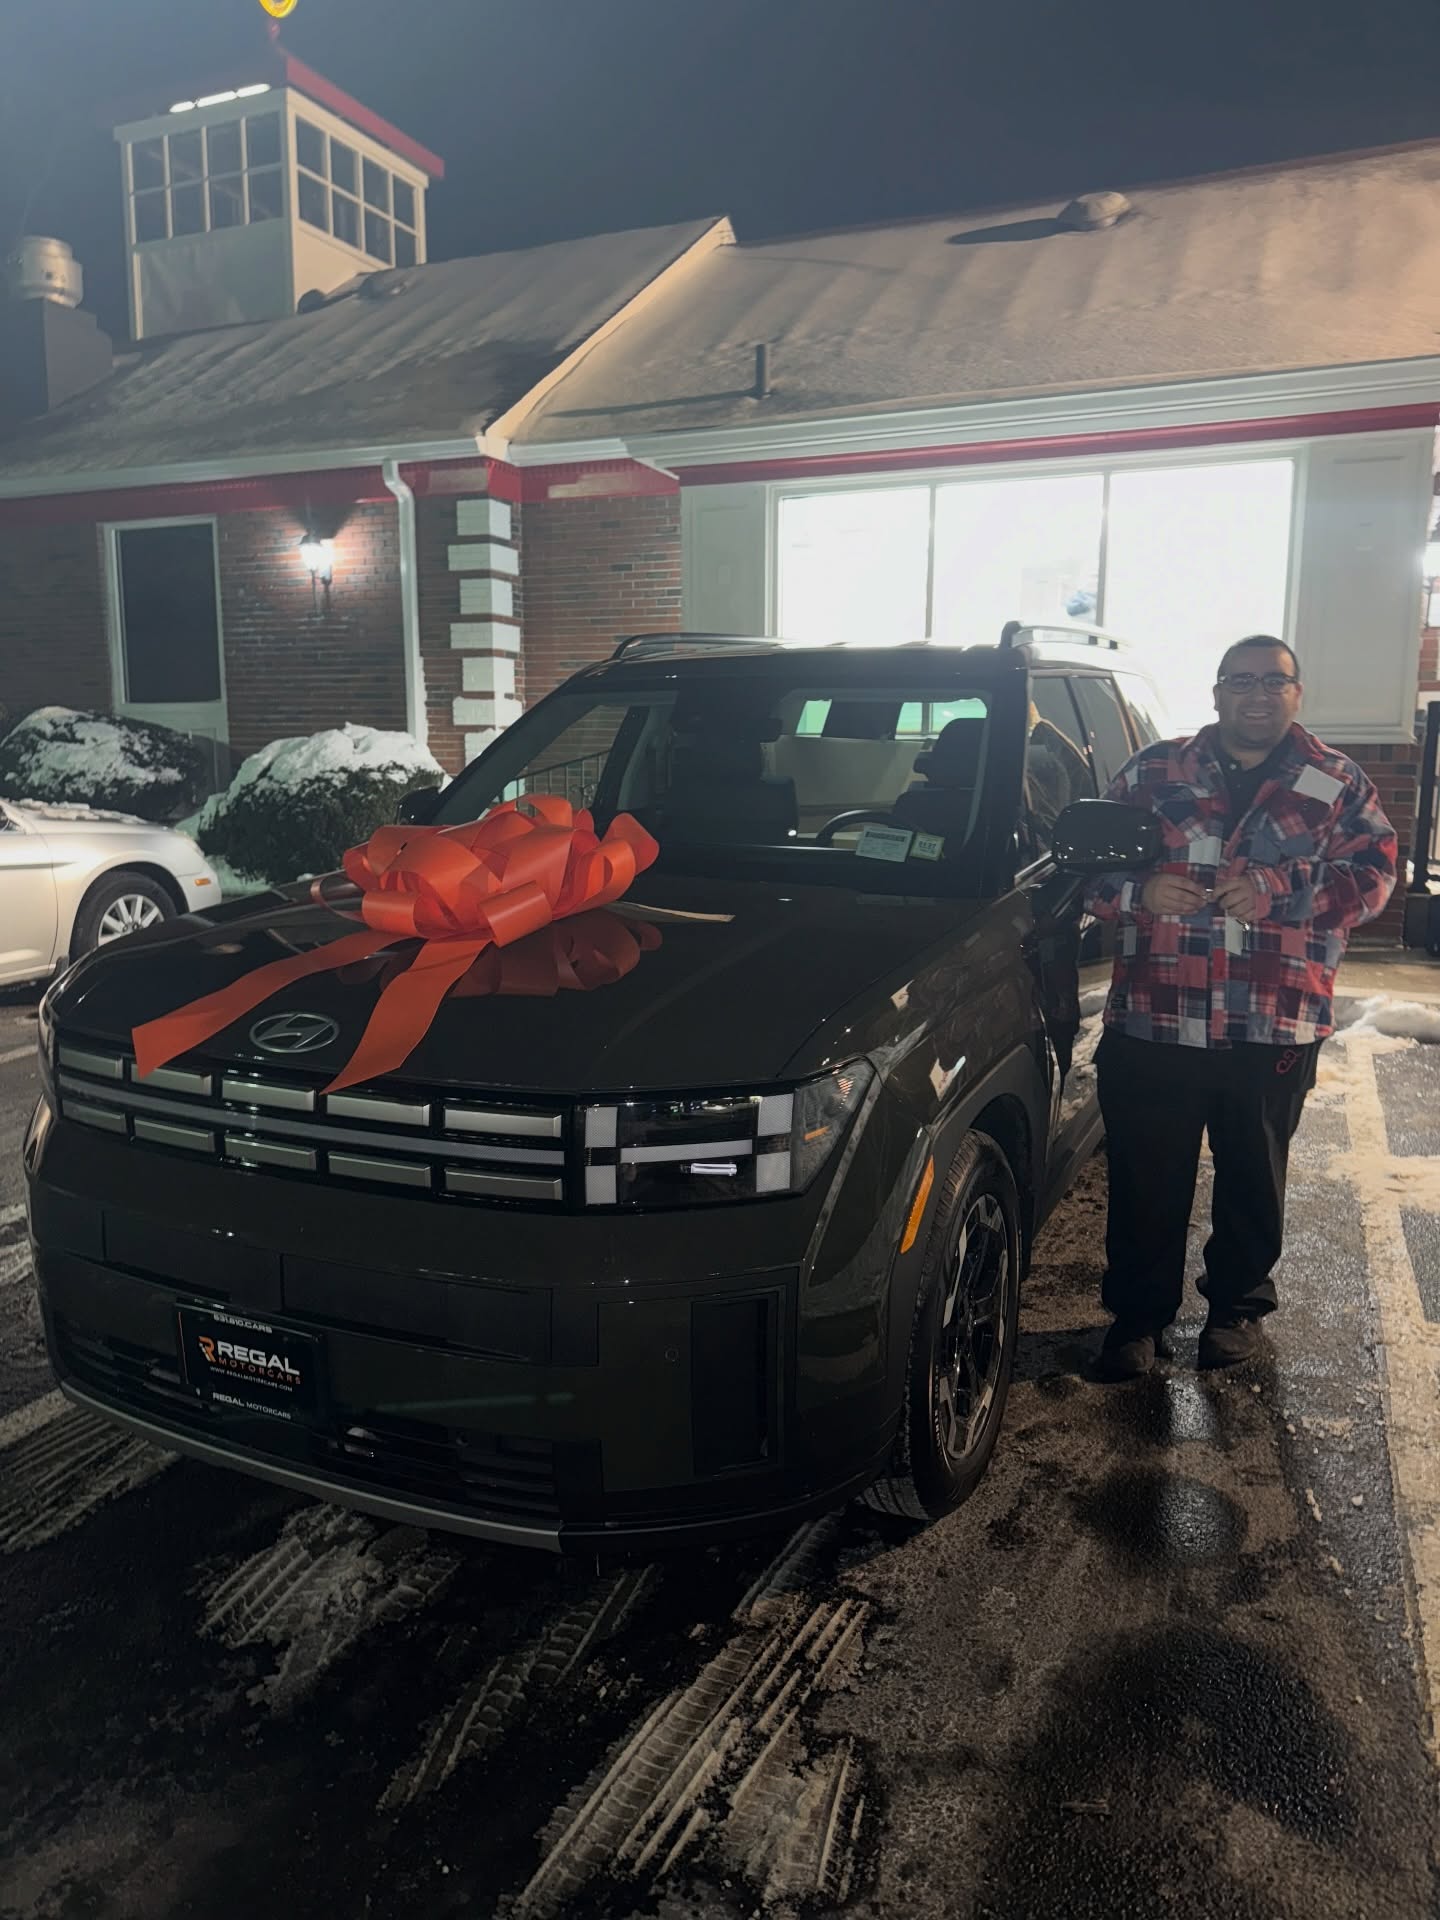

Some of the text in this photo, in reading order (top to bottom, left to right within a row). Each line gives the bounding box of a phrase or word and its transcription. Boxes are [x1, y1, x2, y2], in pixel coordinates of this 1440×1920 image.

[217, 1340, 300, 1375] REGAL
[218, 1357, 301, 1384] MOTORCARS
[212, 1391, 291, 1419] REGAL MOTORCARS
